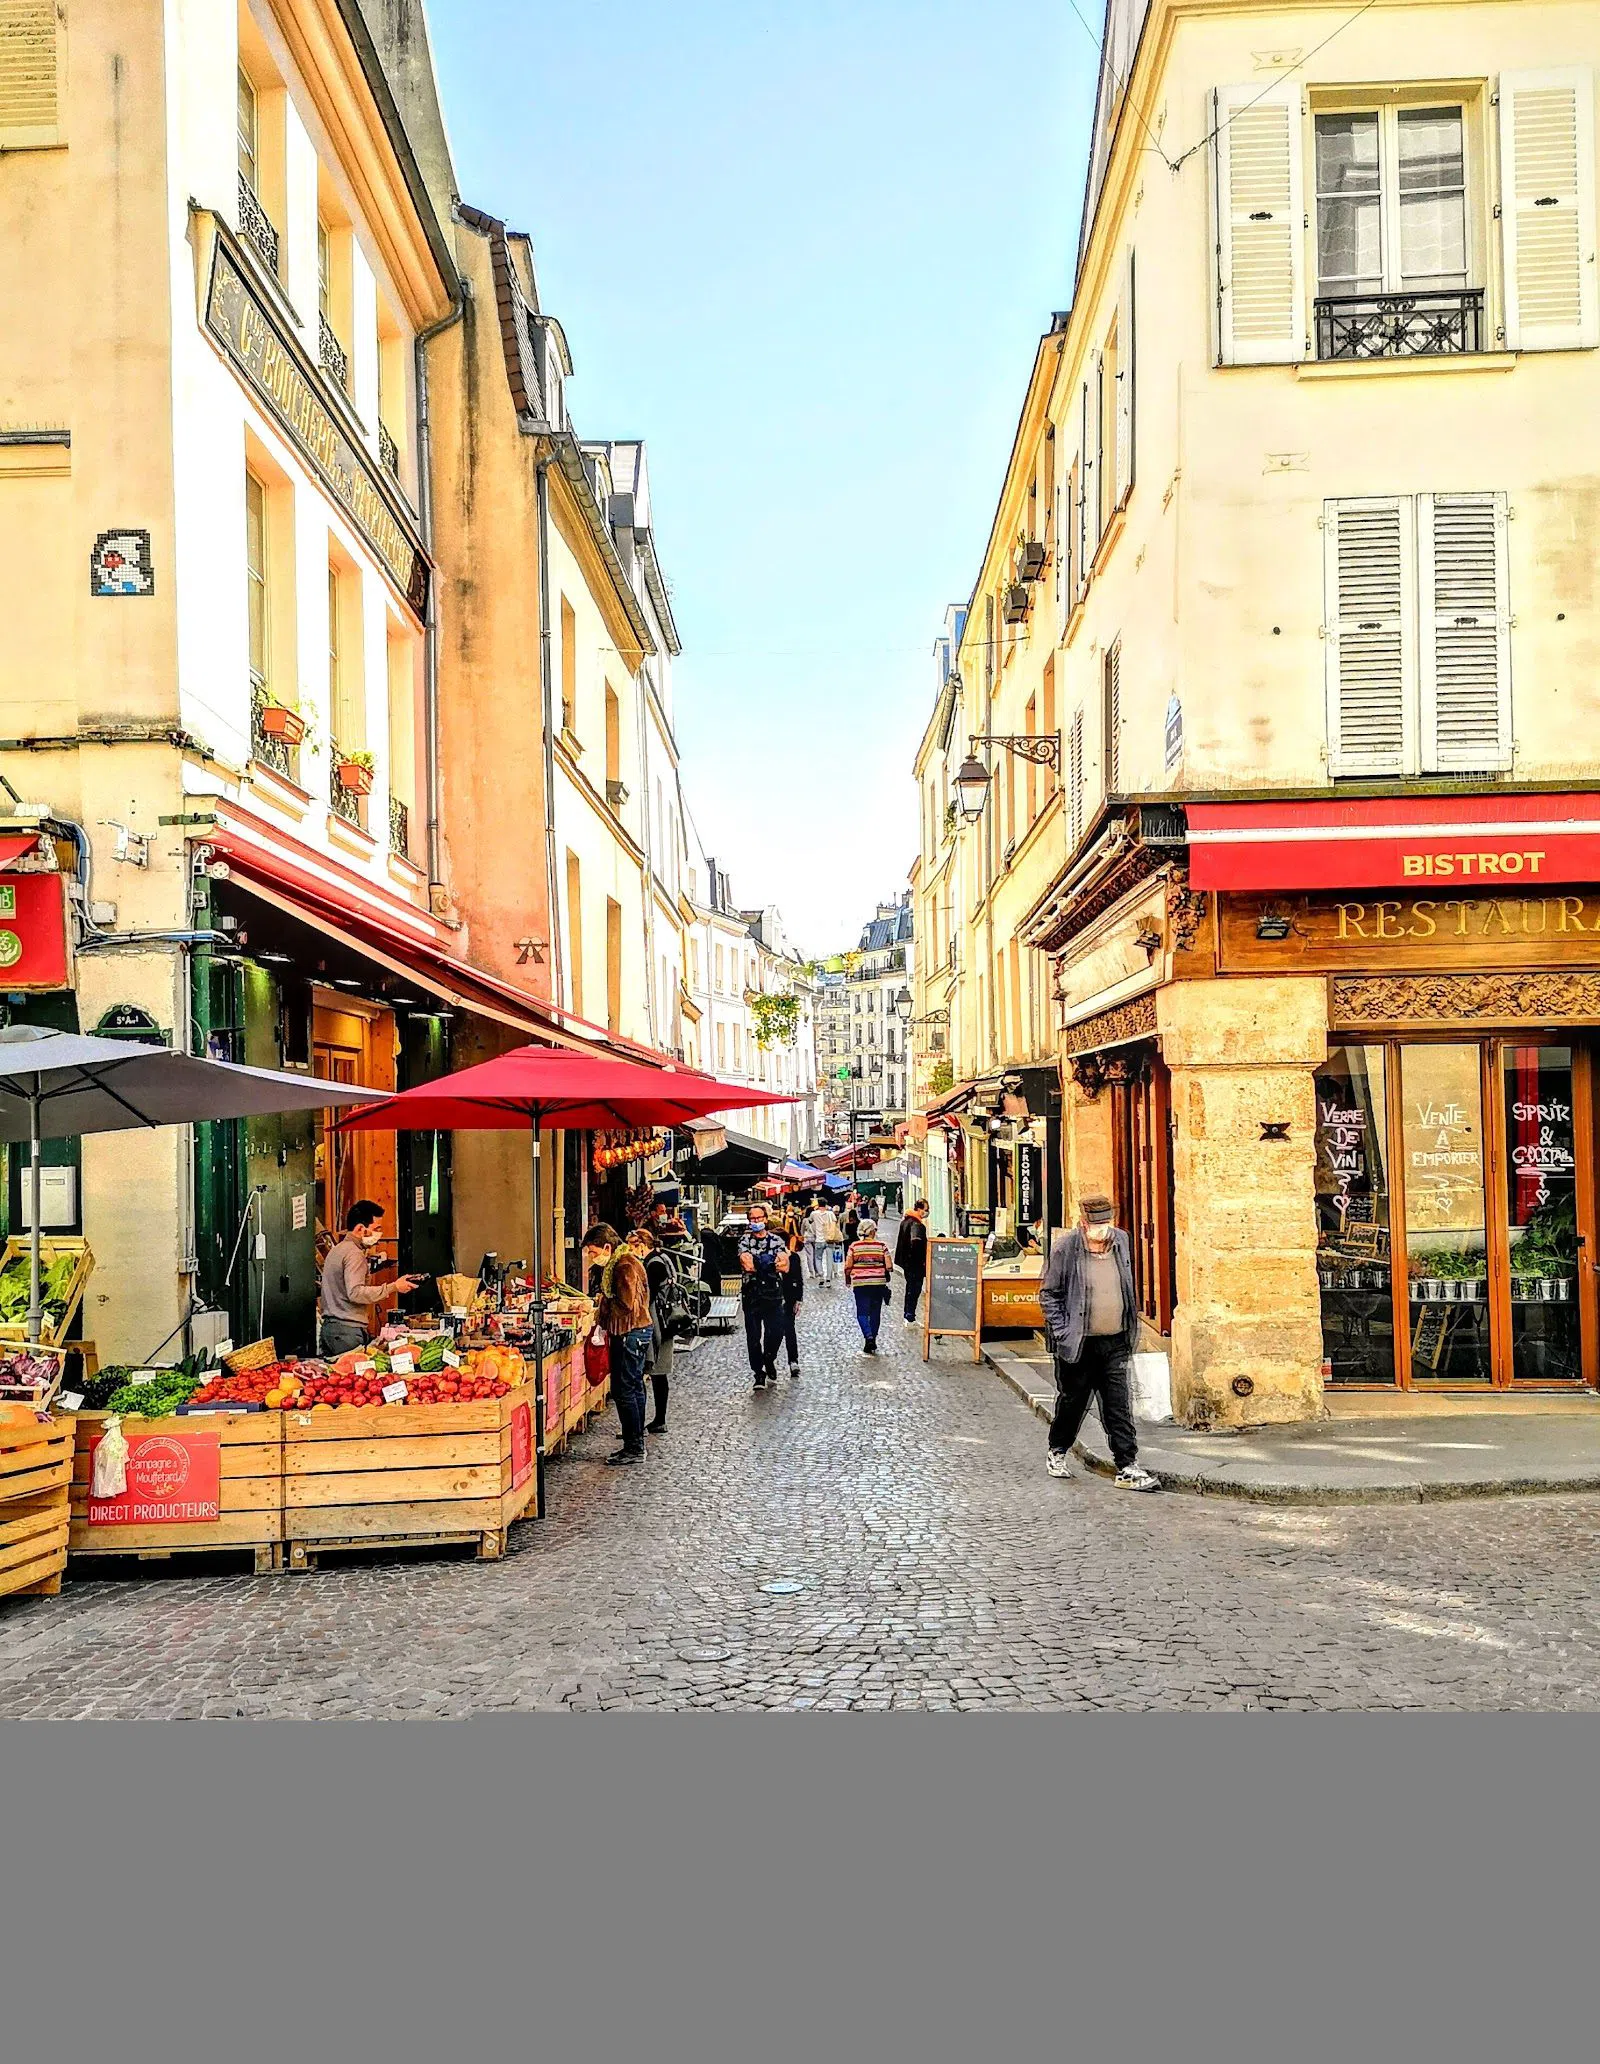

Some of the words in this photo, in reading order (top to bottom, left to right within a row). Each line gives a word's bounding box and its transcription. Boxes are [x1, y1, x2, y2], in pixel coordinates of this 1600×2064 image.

[1402, 851, 1546, 876] BISTROT
[1416, 1101, 1467, 1126] VENTE
[1540, 1125, 1554, 1146] &
[1021, 1146, 1030, 1221] FROMAGERIE
[130, 1458, 172, 1472] Campagne
[90, 1504, 131, 1521] DIRECT
[133, 1501, 218, 1520] PRODUCTEURS
